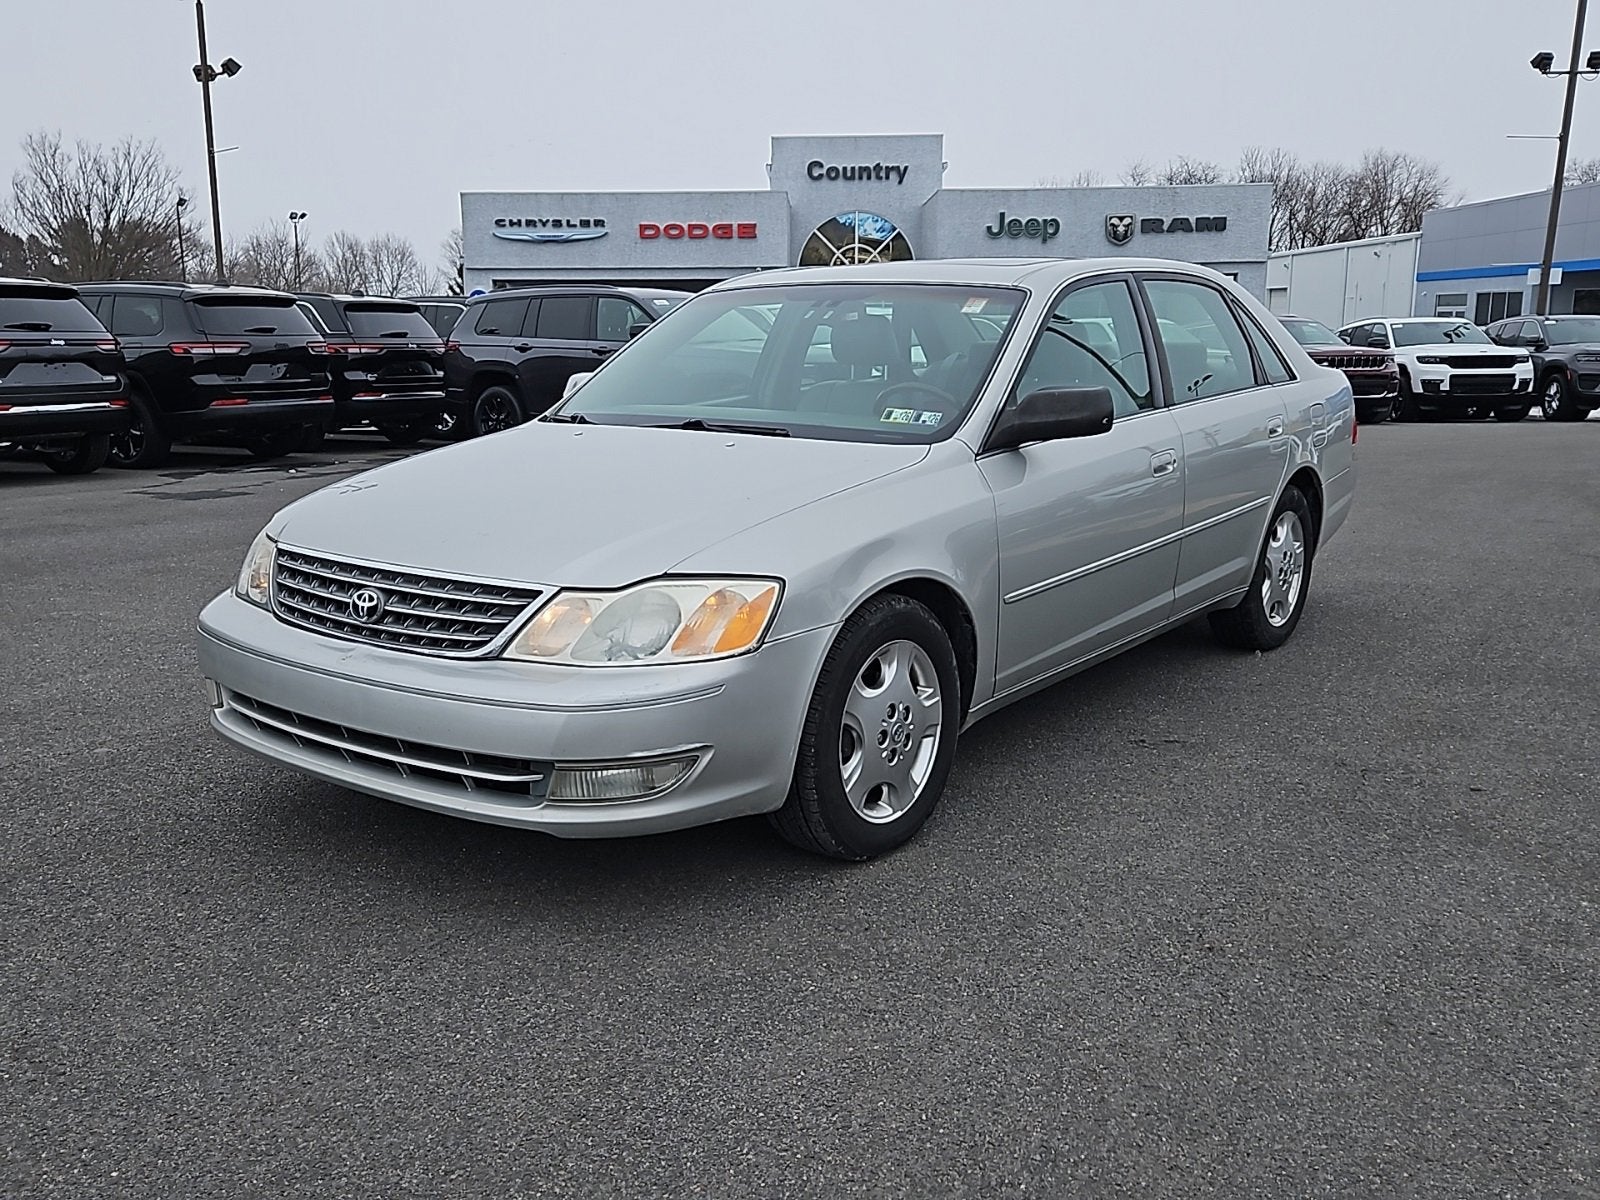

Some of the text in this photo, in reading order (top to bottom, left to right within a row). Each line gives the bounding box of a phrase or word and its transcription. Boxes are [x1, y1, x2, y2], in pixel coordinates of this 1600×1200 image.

[807, 160, 909, 185] Country
[494, 218, 606, 228] CHRYSLER
[639, 223, 757, 239] DODGE
[986, 211, 1061, 243] Jeep
[1140, 216, 1227, 234] RAM
